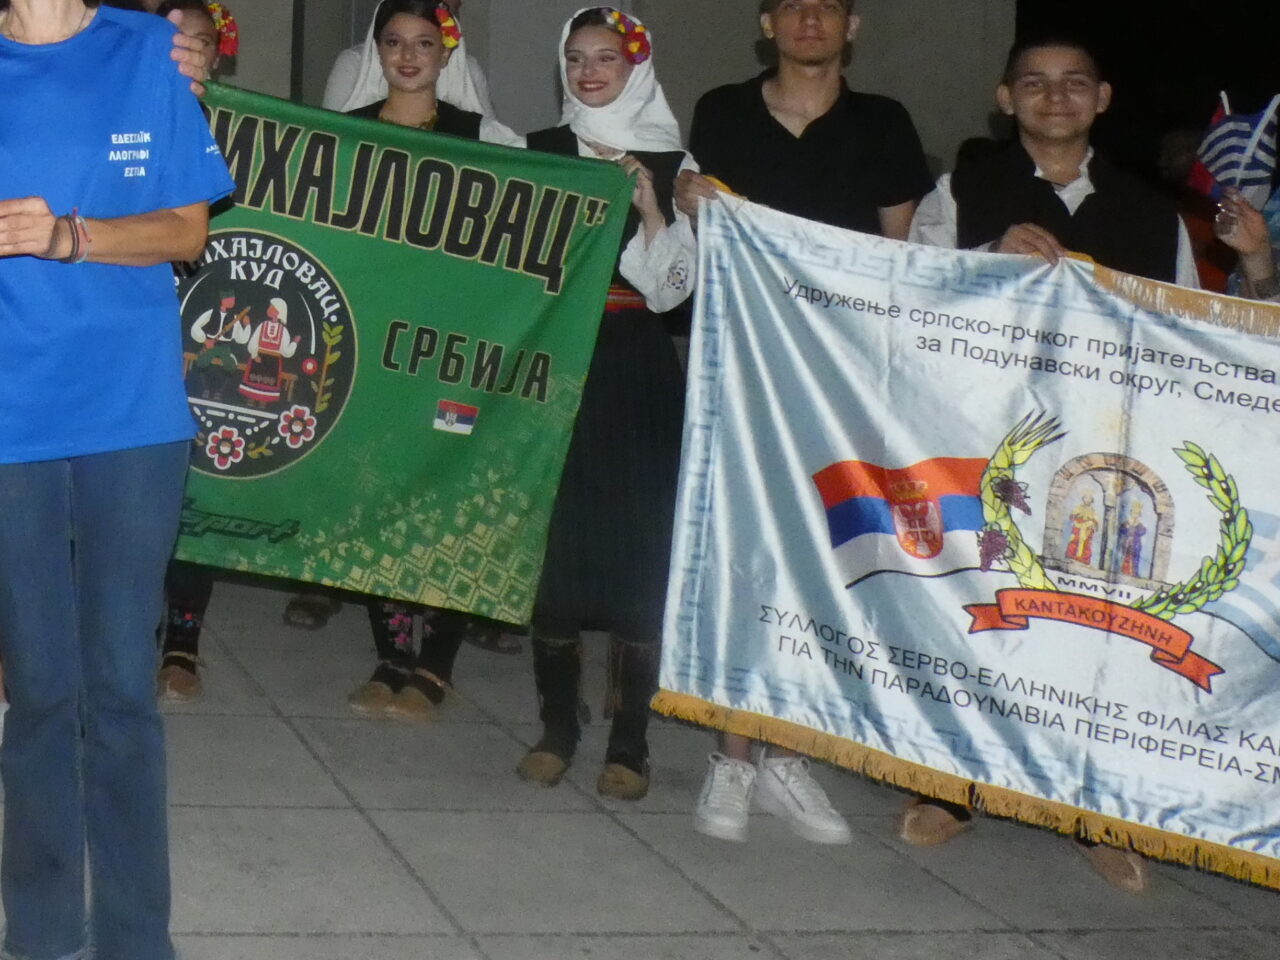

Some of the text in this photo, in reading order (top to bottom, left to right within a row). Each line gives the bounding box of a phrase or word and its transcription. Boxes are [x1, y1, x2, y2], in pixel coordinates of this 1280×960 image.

[202, 105, 610, 295] ИХАЈЛОВАЦ"
[230, 260, 285, 290] КУД
[381, 320, 551, 404] СРБИЈА
[783, 276, 1276, 385] Удружење српско-грчког пријатељства
[916, 335, 942, 353] за
[951, 337, 1100, 381] Подунавски
[1109, 370, 1182, 398] округ,
[1014, 597, 1173, 646] ΚΑΝΤΑΚΟΥΖΗΝΗ
[1057, 576, 1132, 600] MMVII
[759, 605, 880, 660] ΣΥΛΛΟΓΟΣ
[888, 646, 1129, 722] ΣΕΡΒΟ-ΕΛΛΗΝΙΚΗΣ
[1137, 709, 1230, 744] ΦΙΛΙΑΣ
[778, 635, 813, 660] ΓΙΑ
[821, 647, 864, 680] ΤΗΝ
[871, 668, 1066, 732] ΠΑΡΑΔΟΥΝΑΒΙΑ
